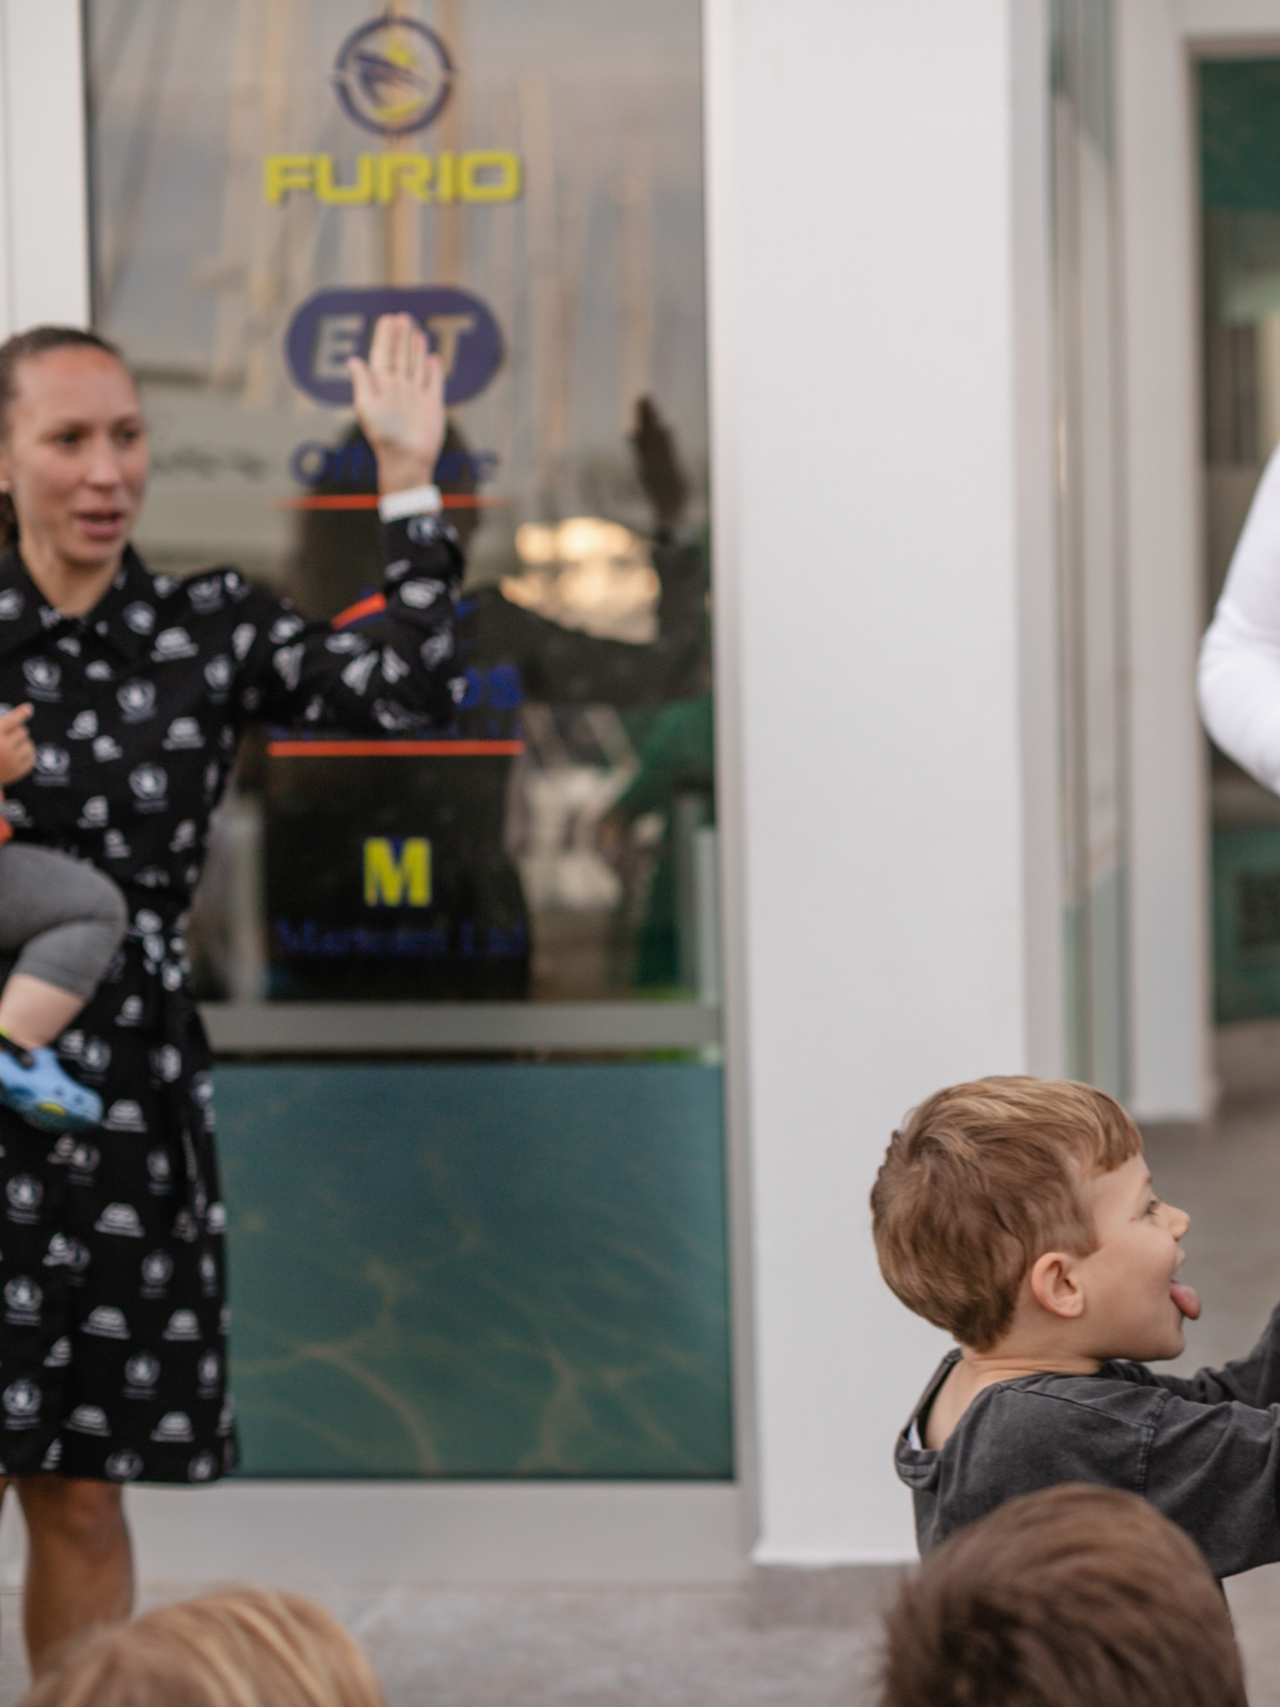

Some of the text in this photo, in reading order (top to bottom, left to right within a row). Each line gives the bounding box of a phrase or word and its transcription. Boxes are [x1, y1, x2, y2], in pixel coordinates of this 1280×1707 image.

[264, 151, 522, 205] FURIO
[313, 311, 477, 382] ET
[362, 836, 433, 909] M
